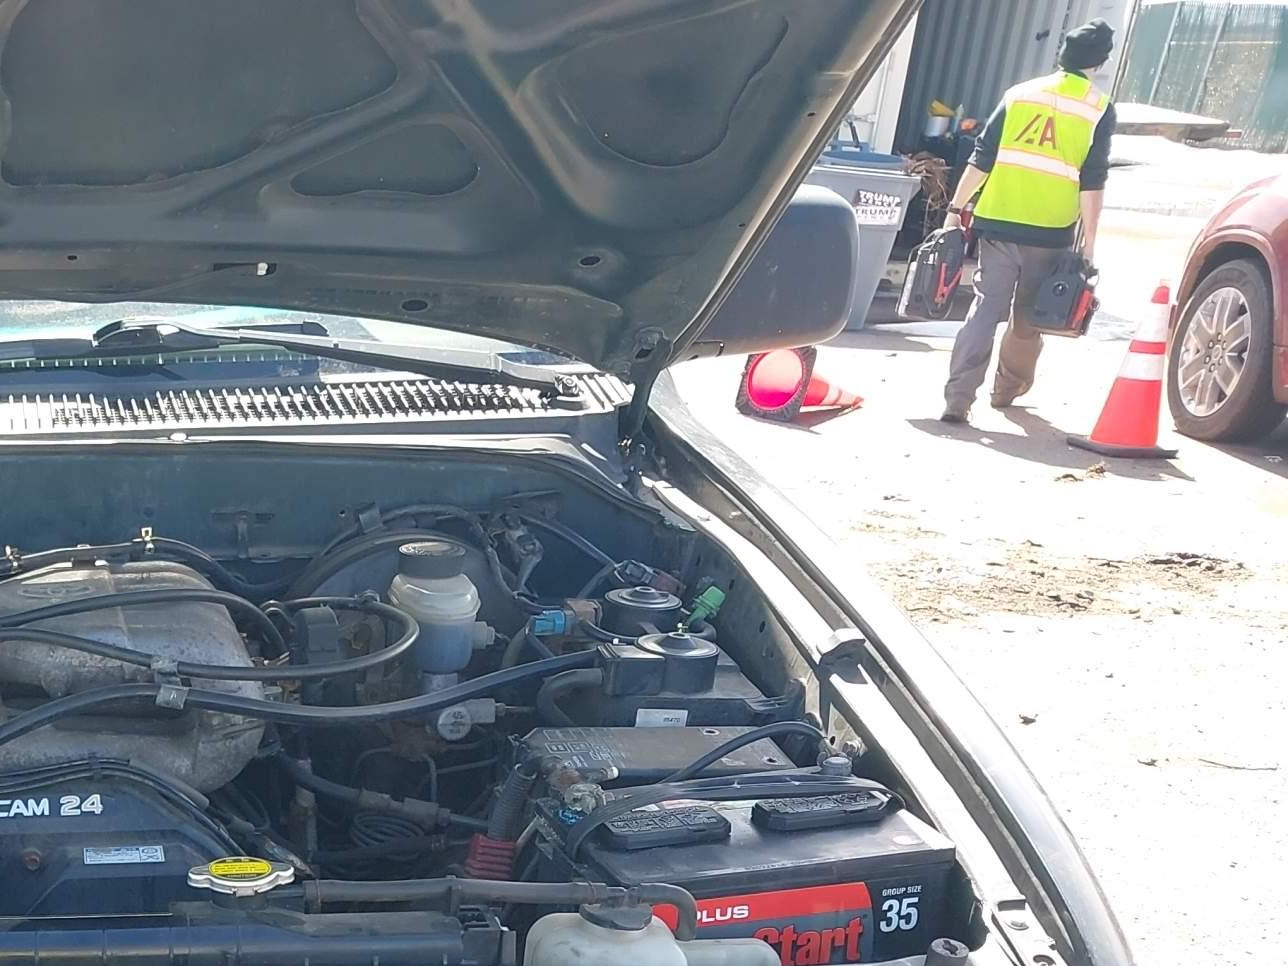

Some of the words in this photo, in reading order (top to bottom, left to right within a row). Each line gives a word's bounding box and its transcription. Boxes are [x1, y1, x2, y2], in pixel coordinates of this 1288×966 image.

[858, 190, 901, 205] TRUMP
[855, 208, 897, 217] TRUMP
[59, 793, 104, 817] 24
[882, 886, 906, 897] GROUP
[906, 884, 922, 894] SIZE
[879, 896, 919, 933] 35
